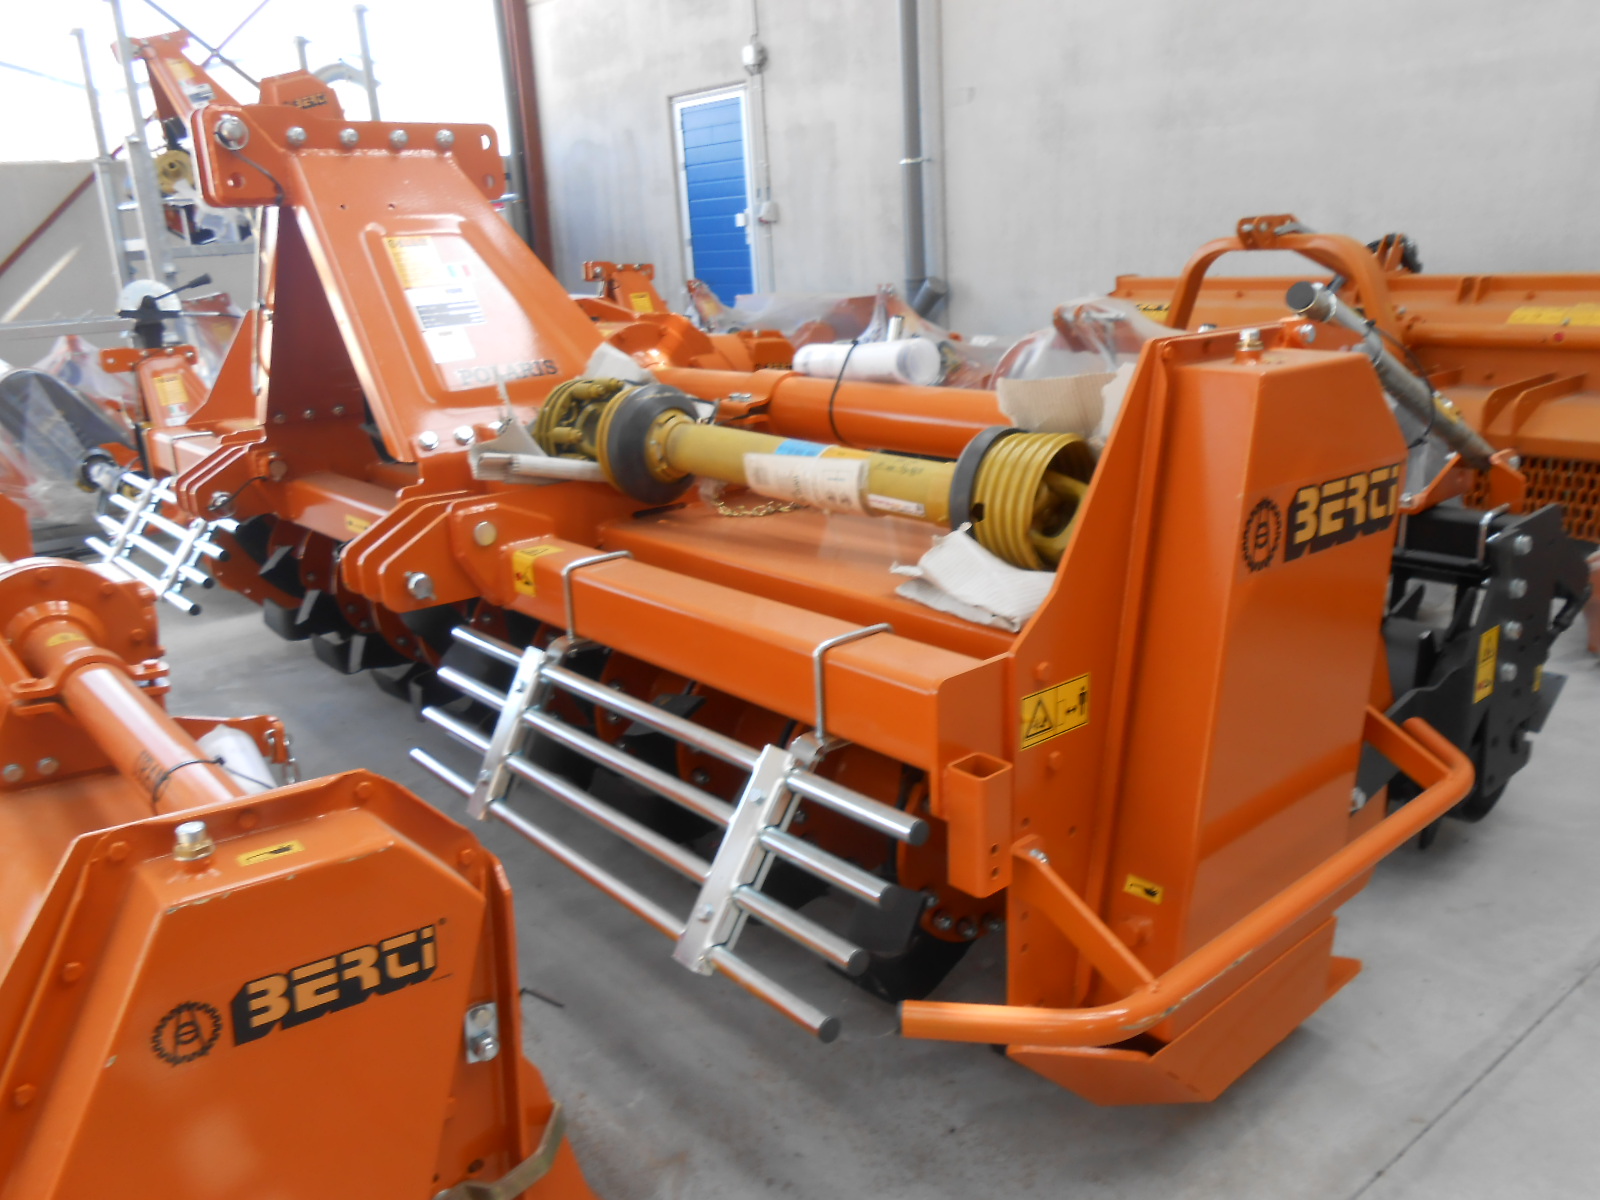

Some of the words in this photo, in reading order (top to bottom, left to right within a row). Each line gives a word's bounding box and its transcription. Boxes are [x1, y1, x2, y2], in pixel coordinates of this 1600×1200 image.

[457, 360, 558, 386] POLARIS
[1286, 464, 1400, 557] BERTI
[234, 925, 437, 1042] BERTI
